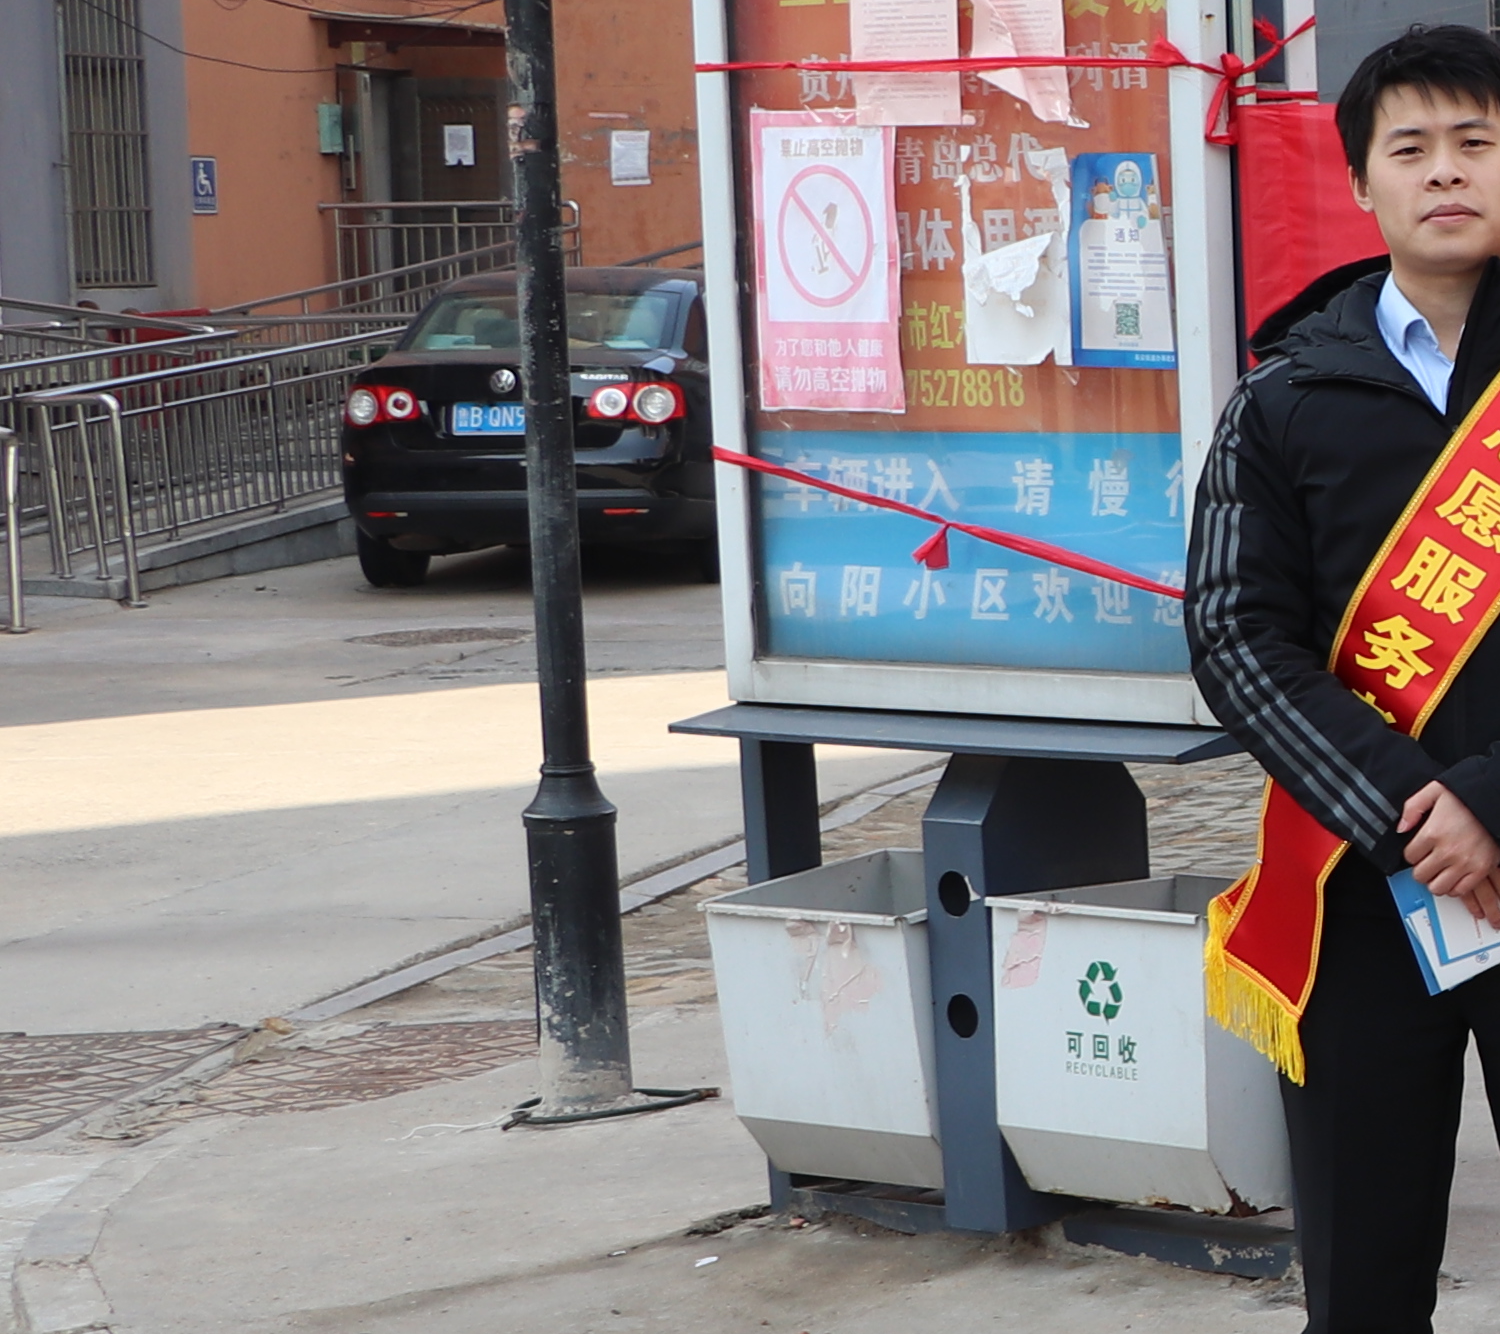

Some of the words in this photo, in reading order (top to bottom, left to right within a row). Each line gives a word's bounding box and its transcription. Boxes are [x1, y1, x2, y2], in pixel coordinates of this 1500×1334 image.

[1114, 227, 1141, 243] 通知
[905, 299, 967, 352] 市红
[1065, 1030, 1138, 1064] 可回收
[1065, 1060, 1139, 1082] RECYCLABLE
